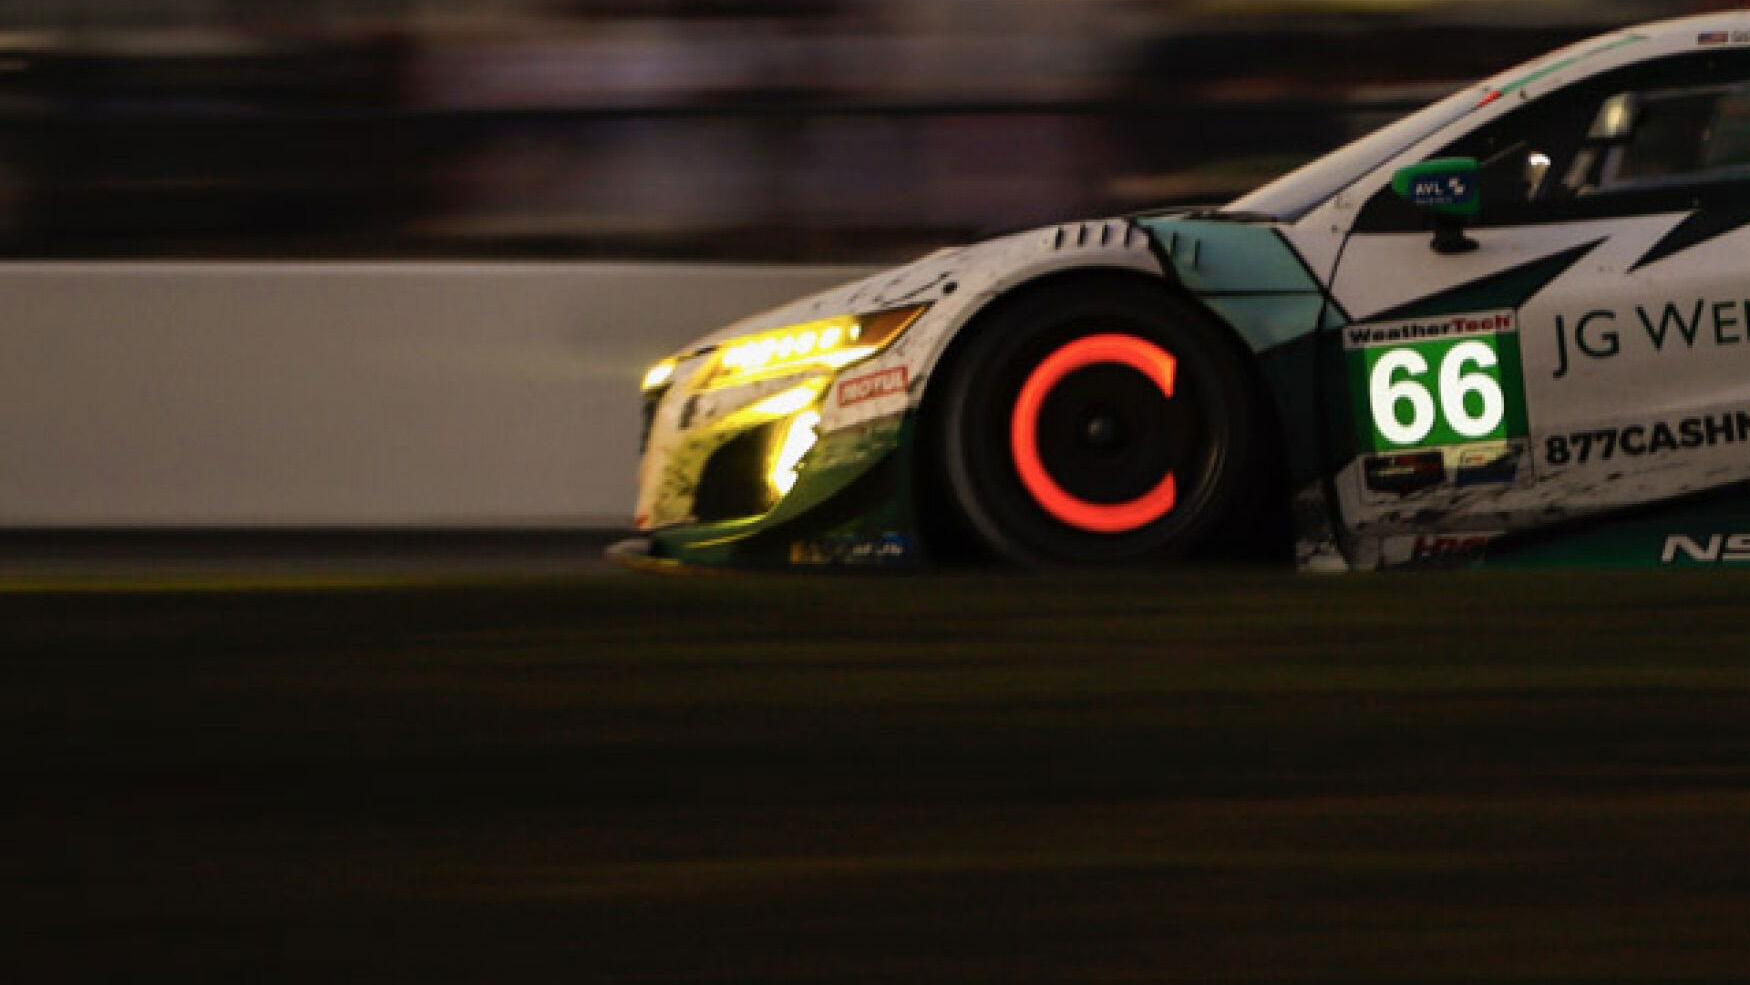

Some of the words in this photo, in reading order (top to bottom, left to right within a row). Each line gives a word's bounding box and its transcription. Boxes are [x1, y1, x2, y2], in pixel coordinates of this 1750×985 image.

[1348, 315, 1512, 344] WeatherTech
[1552, 309, 1621, 379] JG
[1369, 340, 1505, 446] 66
